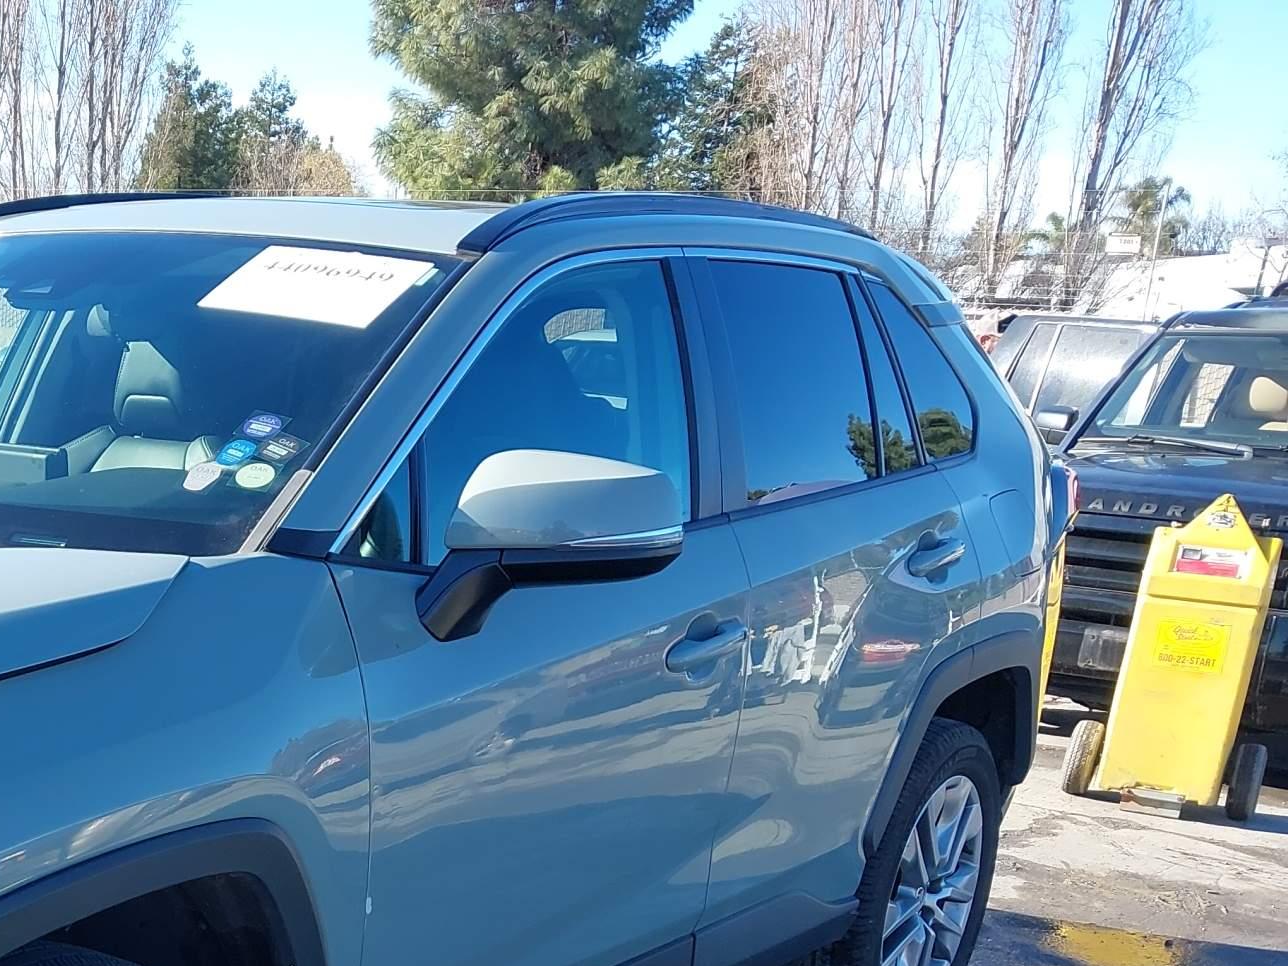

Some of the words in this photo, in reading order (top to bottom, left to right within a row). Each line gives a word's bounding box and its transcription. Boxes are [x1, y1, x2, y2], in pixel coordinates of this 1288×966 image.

[259, 416, 278, 425] OAK
[231, 442, 252, 454] OAK
[278, 438, 297, 448] OAK
[197, 465, 216, 476] OAK
